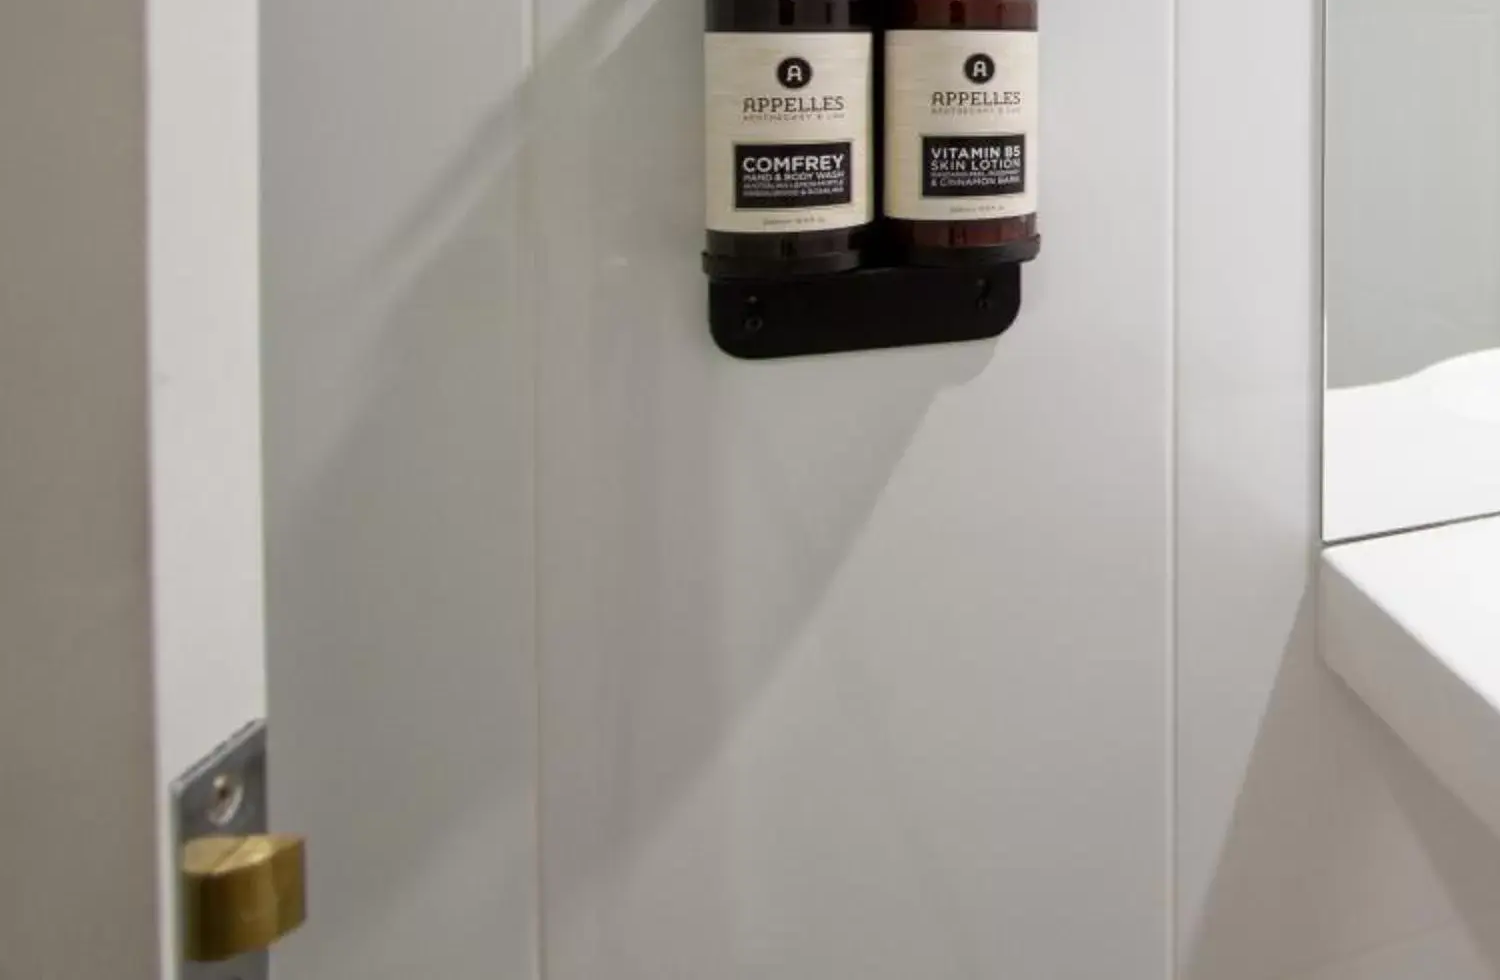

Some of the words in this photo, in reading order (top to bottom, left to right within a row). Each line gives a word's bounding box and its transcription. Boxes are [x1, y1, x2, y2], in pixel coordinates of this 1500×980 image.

[743, 95, 845, 113] APPELLES
[931, 91, 1021, 107] APPELLES
[930, 147, 1001, 160] VITAMIN
[1004, 145, 1021, 158] B5
[743, 153, 845, 173] COMFREY
[930, 159, 966, 171] SKIN
[970, 157, 1021, 171] LOTION
[783, 171, 814, 181] BODY
[815, 169, 845, 180] WASH
